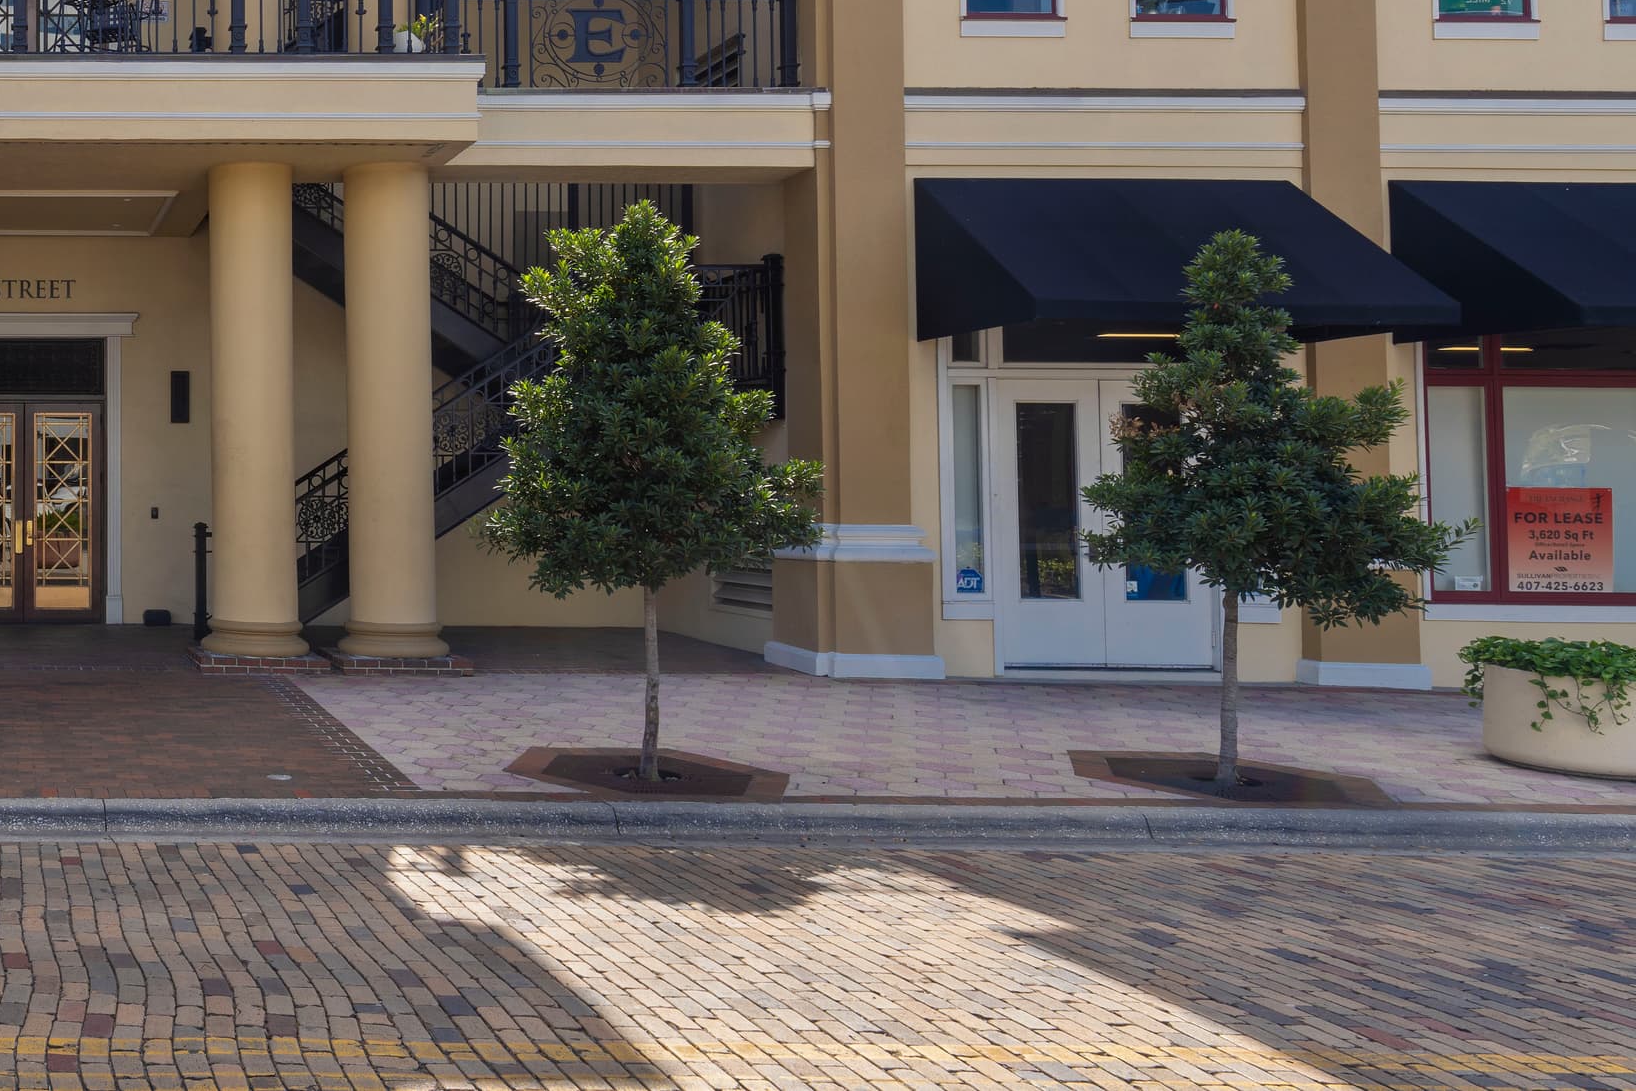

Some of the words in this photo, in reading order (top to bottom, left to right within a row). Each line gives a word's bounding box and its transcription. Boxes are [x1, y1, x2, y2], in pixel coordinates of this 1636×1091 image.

[1514, 512, 1548, 524] FOR
[1554, 512, 1604, 524] LEASE
[1564, 530, 1579, 542] Sq
[1582, 530, 1595, 540] Ft
[1528, 550, 1592, 561] Available
[956, 577, 980, 589] ADT
[1517, 581, 1604, 591] 407-425-6623
